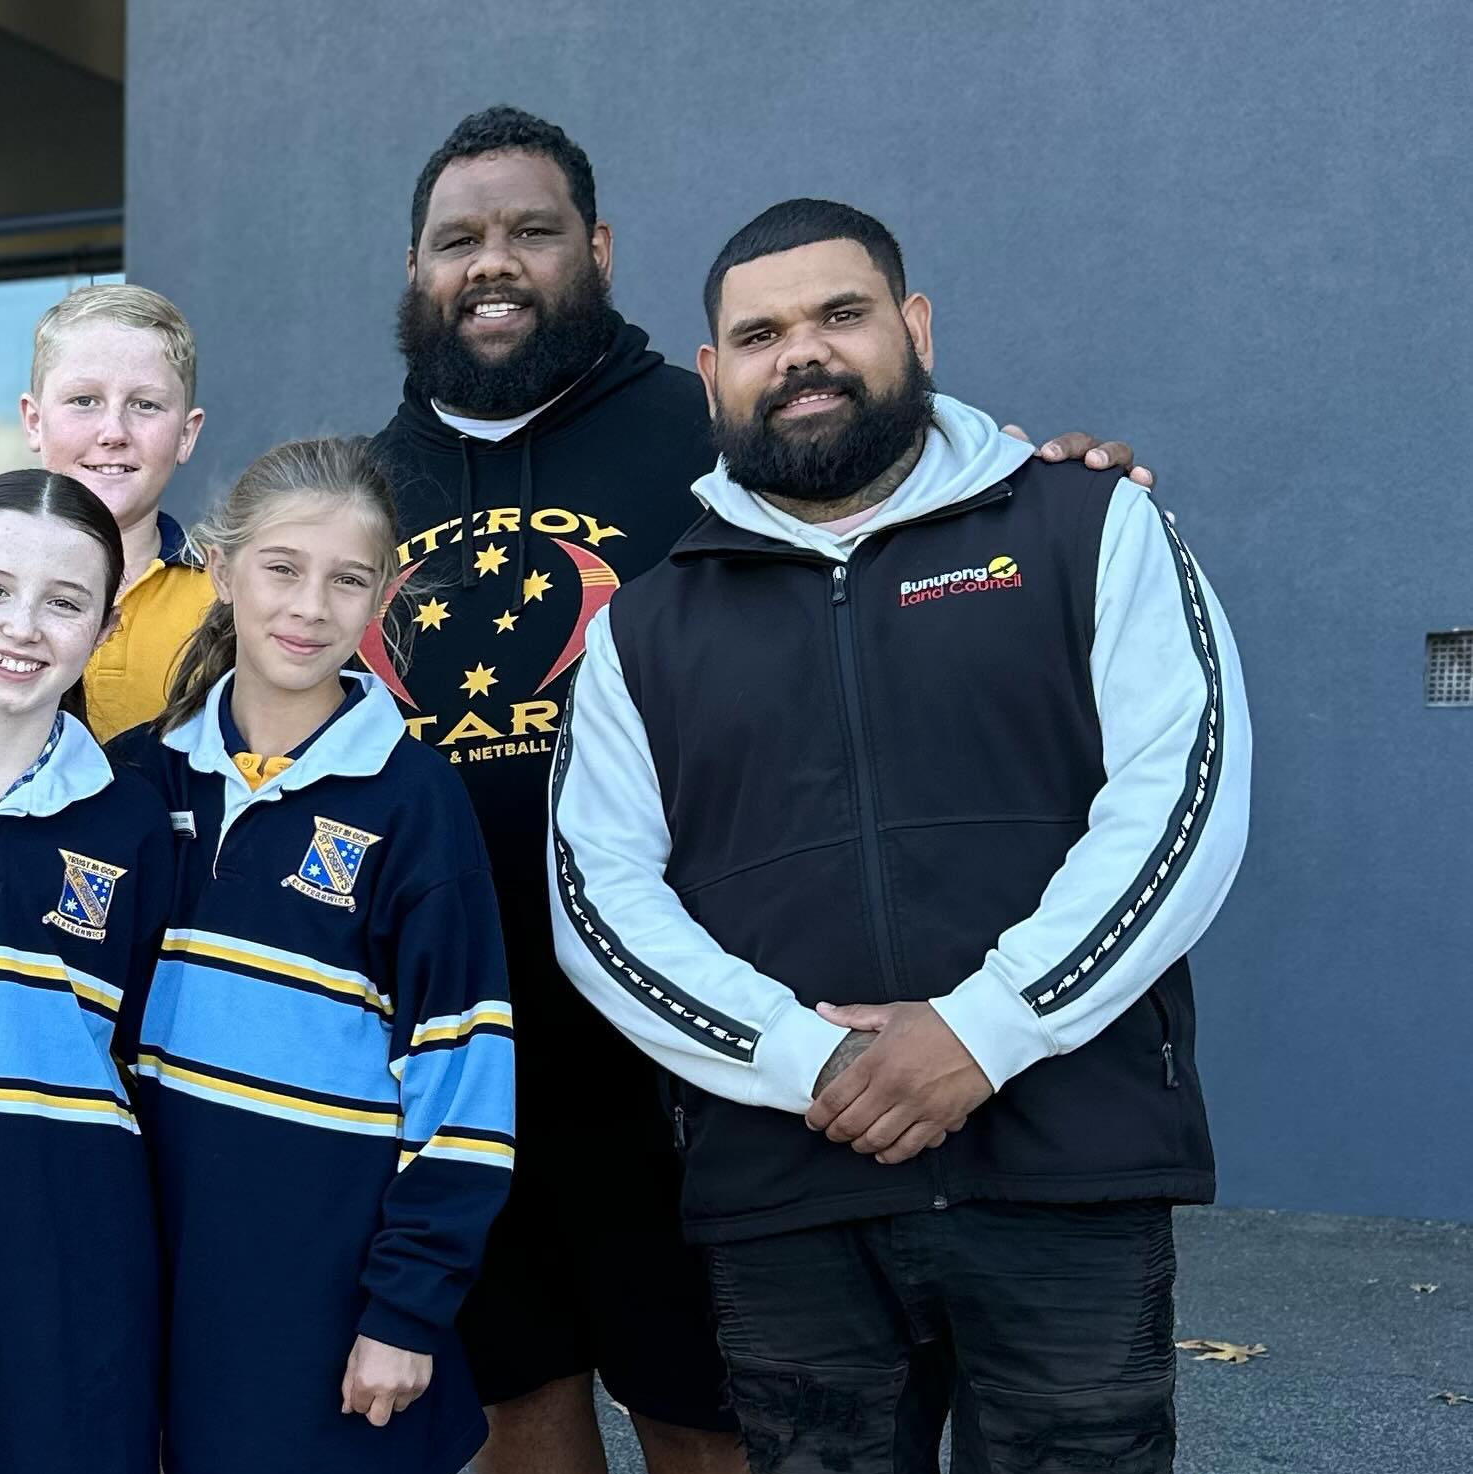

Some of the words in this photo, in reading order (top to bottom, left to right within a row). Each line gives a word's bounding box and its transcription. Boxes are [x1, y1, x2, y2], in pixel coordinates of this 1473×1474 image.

[396, 507, 627, 568] ITZROY
[900, 567, 988, 595] Bunurong
[900, 587, 945, 607] Land
[949, 573, 1023, 595] Council
[405, 700, 560, 747] TAR
[449, 751, 462, 764] &
[469, 738, 552, 762] NETBALL
[319, 821, 343, 833] TRUST
[352, 832, 370, 843] GOD
